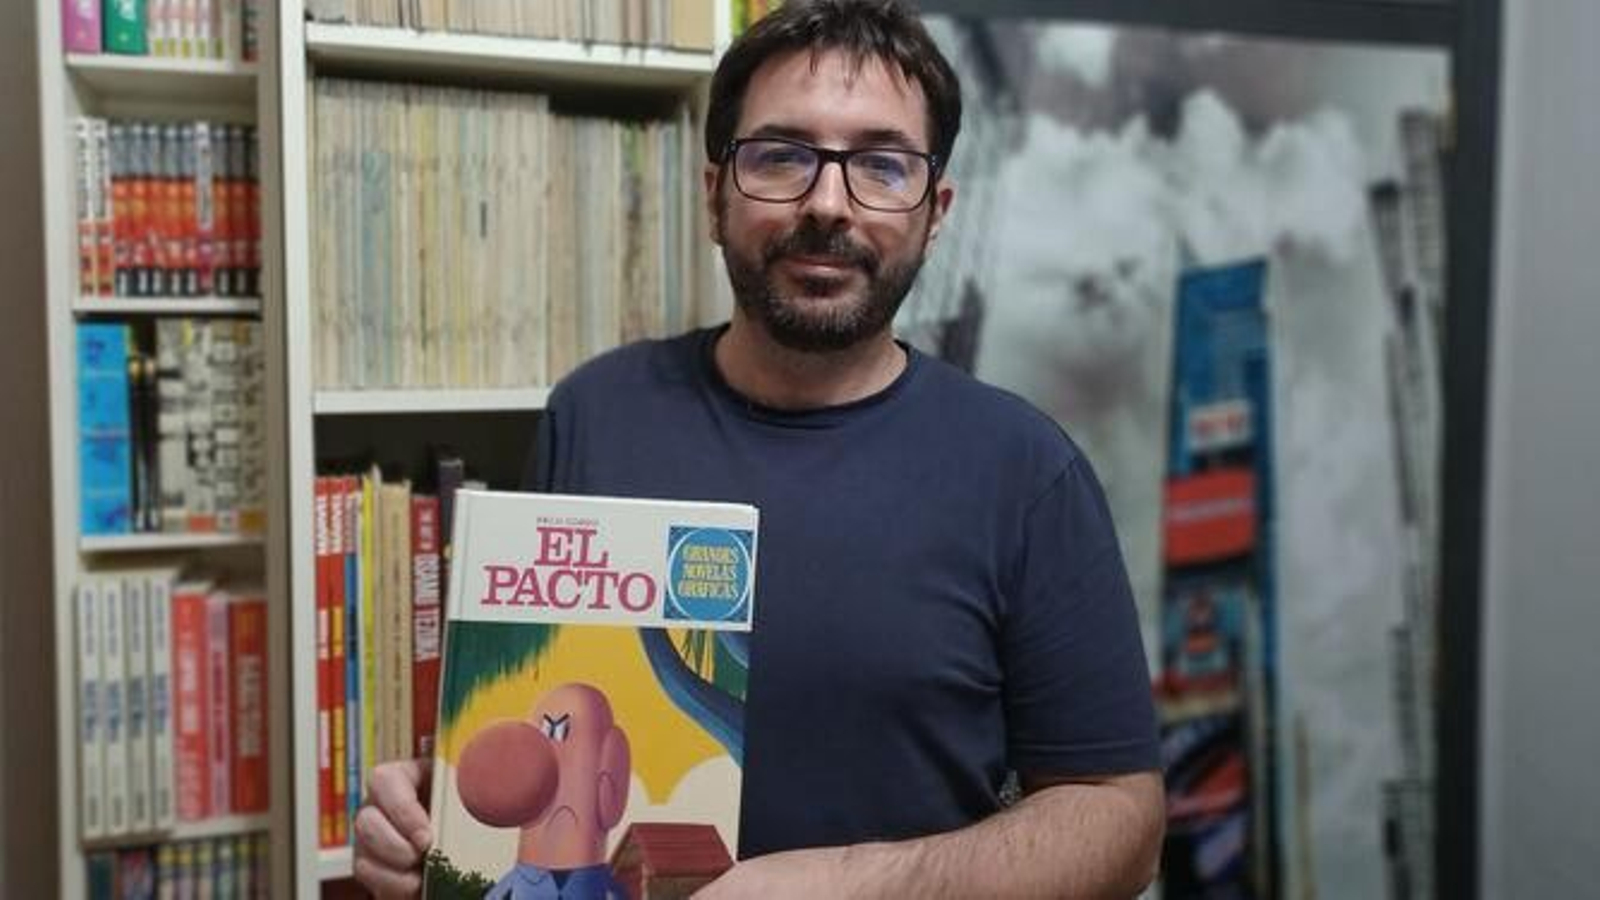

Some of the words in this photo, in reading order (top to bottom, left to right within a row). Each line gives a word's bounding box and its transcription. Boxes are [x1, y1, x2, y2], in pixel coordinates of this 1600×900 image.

[534, 527, 608, 568] EL
[683, 544, 739, 564] GRANDES
[481, 565, 658, 612] PACTO
